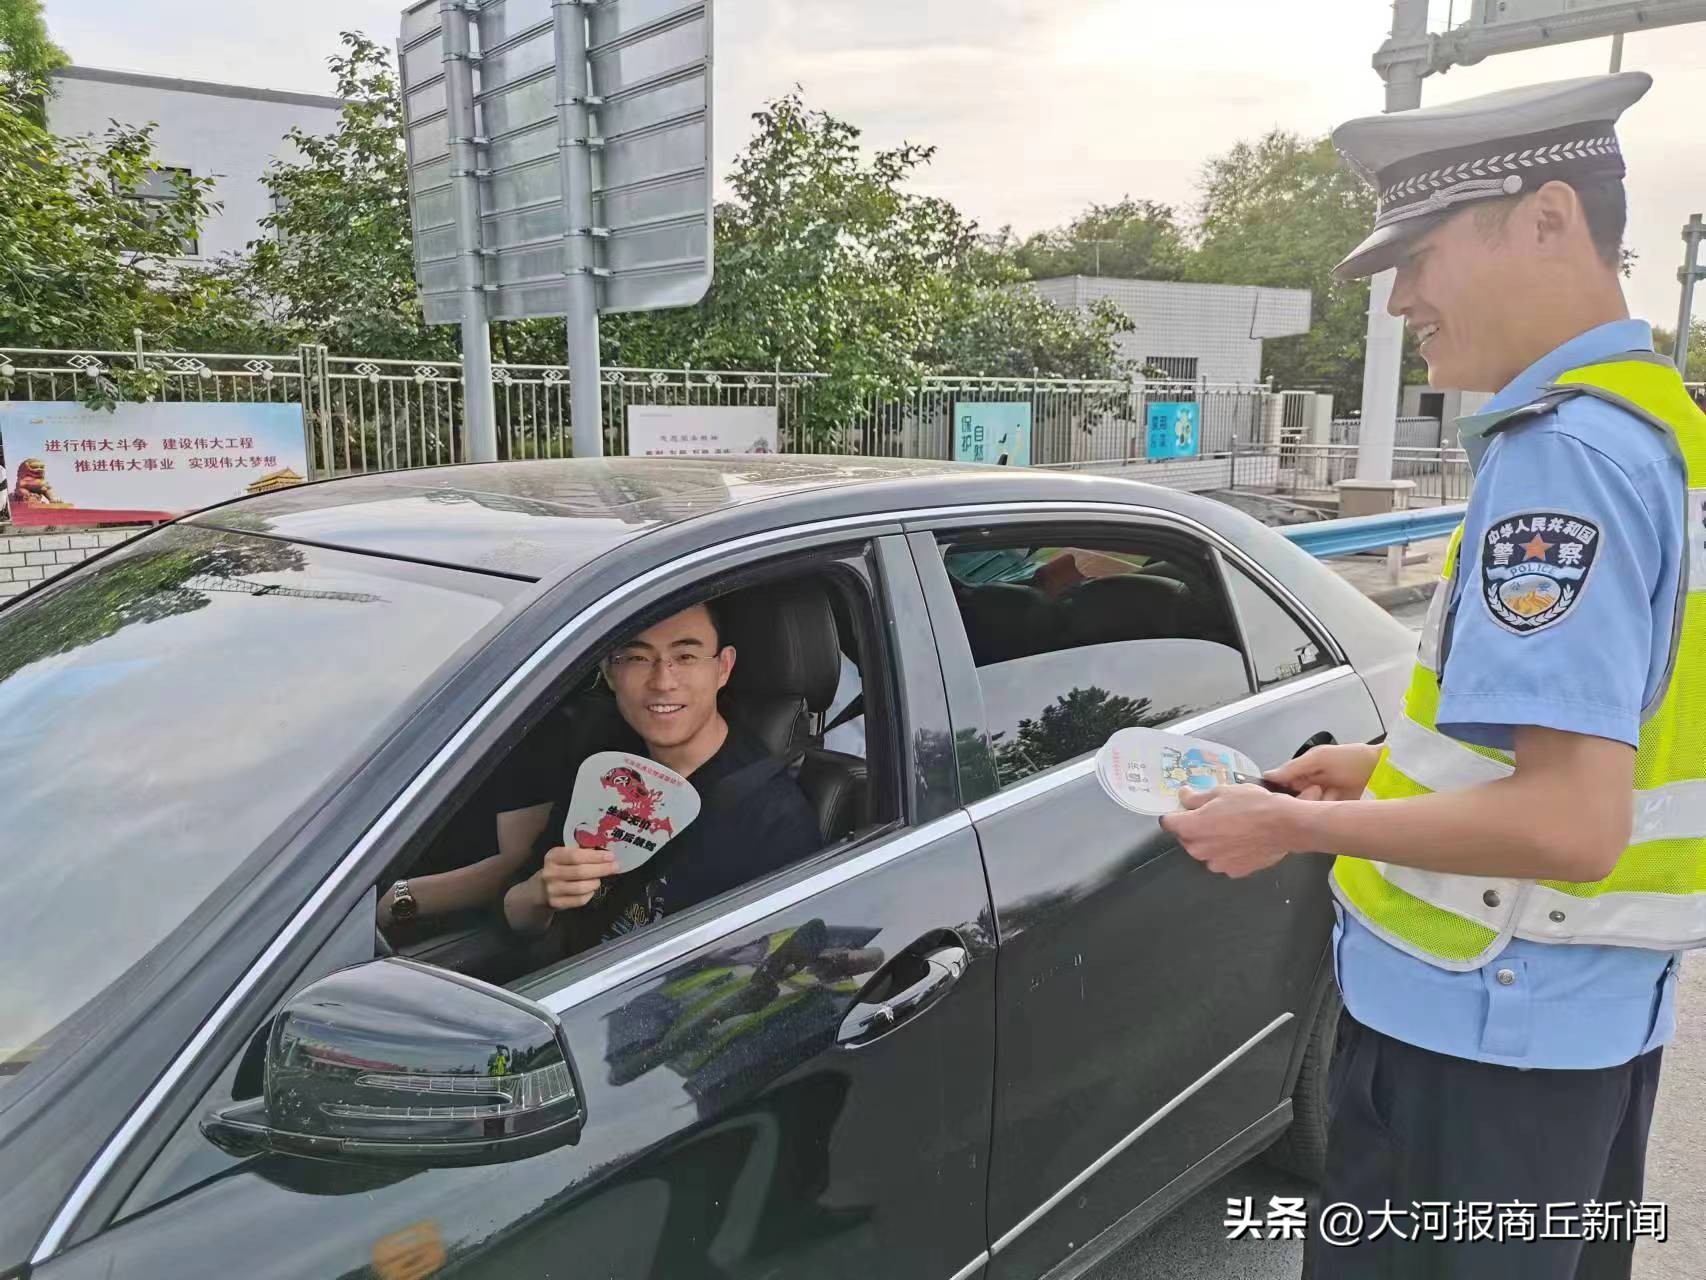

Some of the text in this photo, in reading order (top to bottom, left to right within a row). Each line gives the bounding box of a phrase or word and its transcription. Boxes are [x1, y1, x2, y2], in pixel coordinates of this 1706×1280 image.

[45, 437, 254, 452] 进行伟大斗争 建设伟大工程
[961, 415, 972, 452] 保护
[974, 425, 984, 461] 自然
[74, 455, 278, 473] 推进伟大事业 实现伟大梦想
[1487, 517, 1597, 545] 中华人民共和国
[1492, 542, 1583, 565] 警 察
[1510, 563, 1559, 576] POLICE
